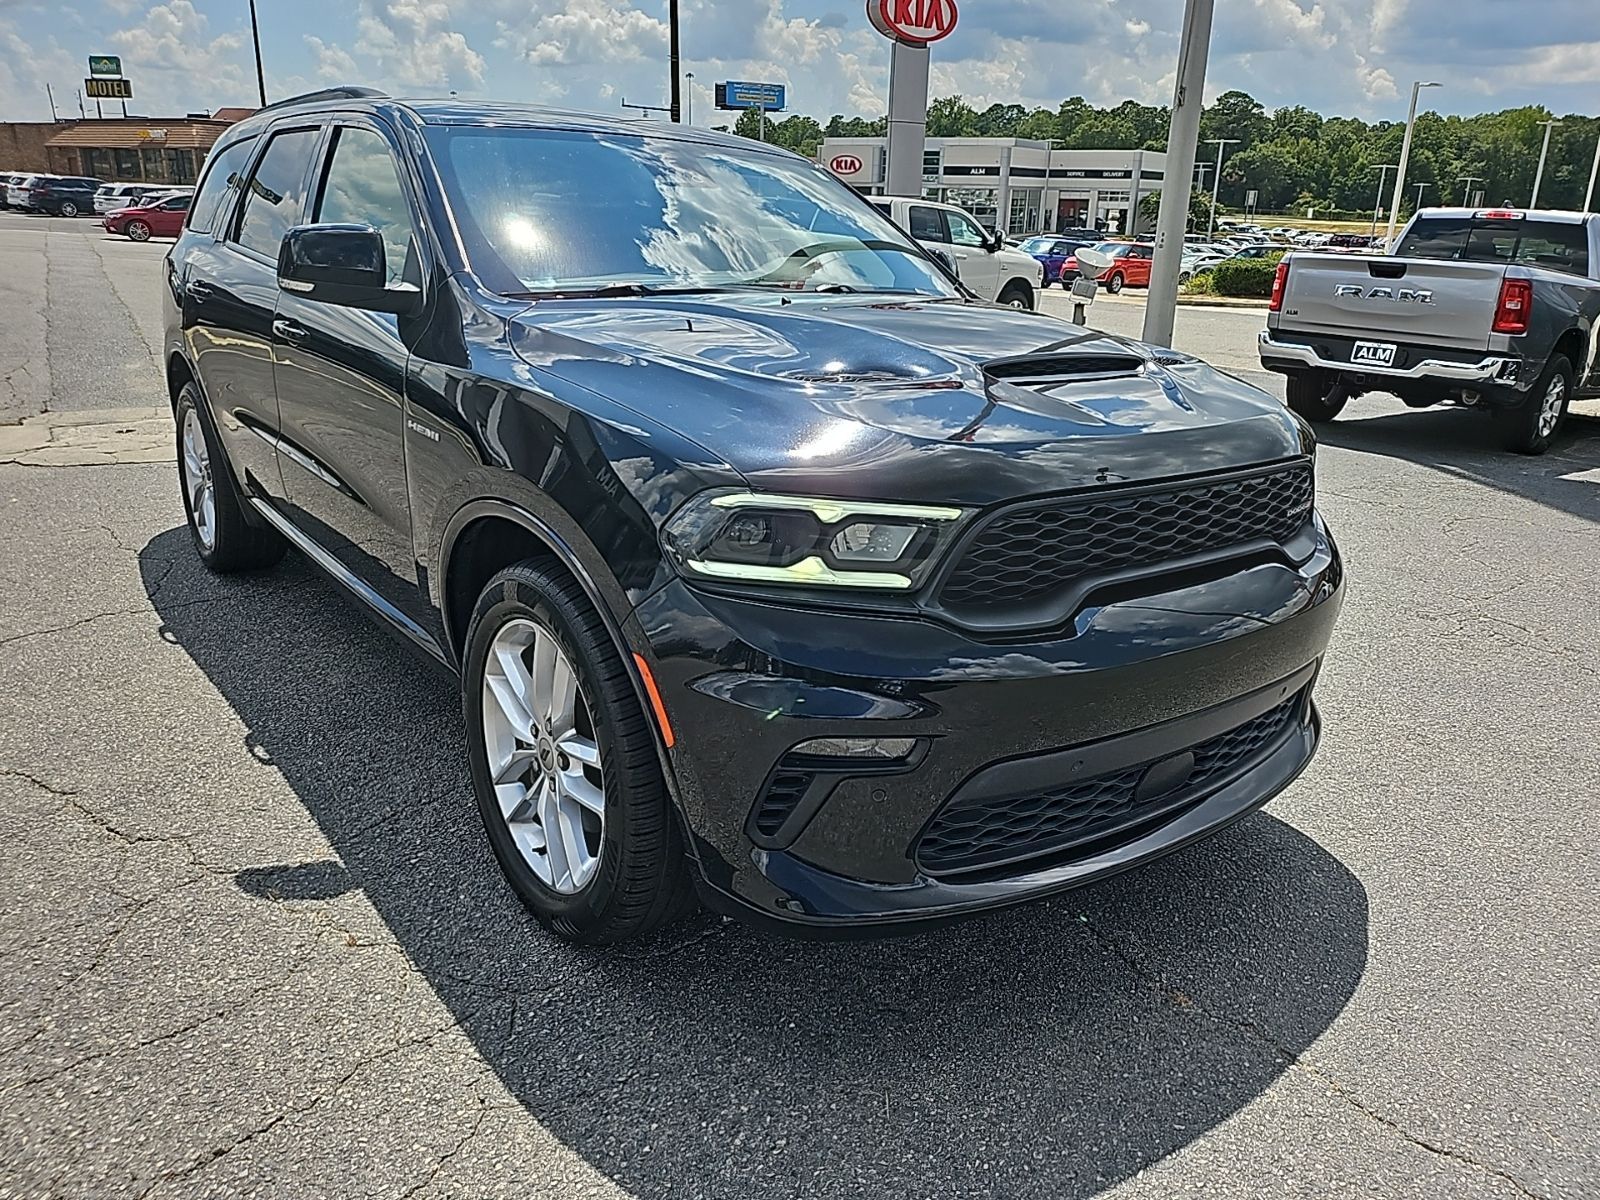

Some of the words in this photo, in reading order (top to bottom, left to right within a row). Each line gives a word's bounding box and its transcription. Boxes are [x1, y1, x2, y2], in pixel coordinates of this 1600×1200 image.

[893, 0, 945, 31] KIA
[86, 81, 129, 96] MOTEL
[835, 159, 857, 170] KIA
[1334, 284, 1434, 304] RAM
[1357, 347, 1392, 361] ALM
[407, 420, 439, 442] HEMI
